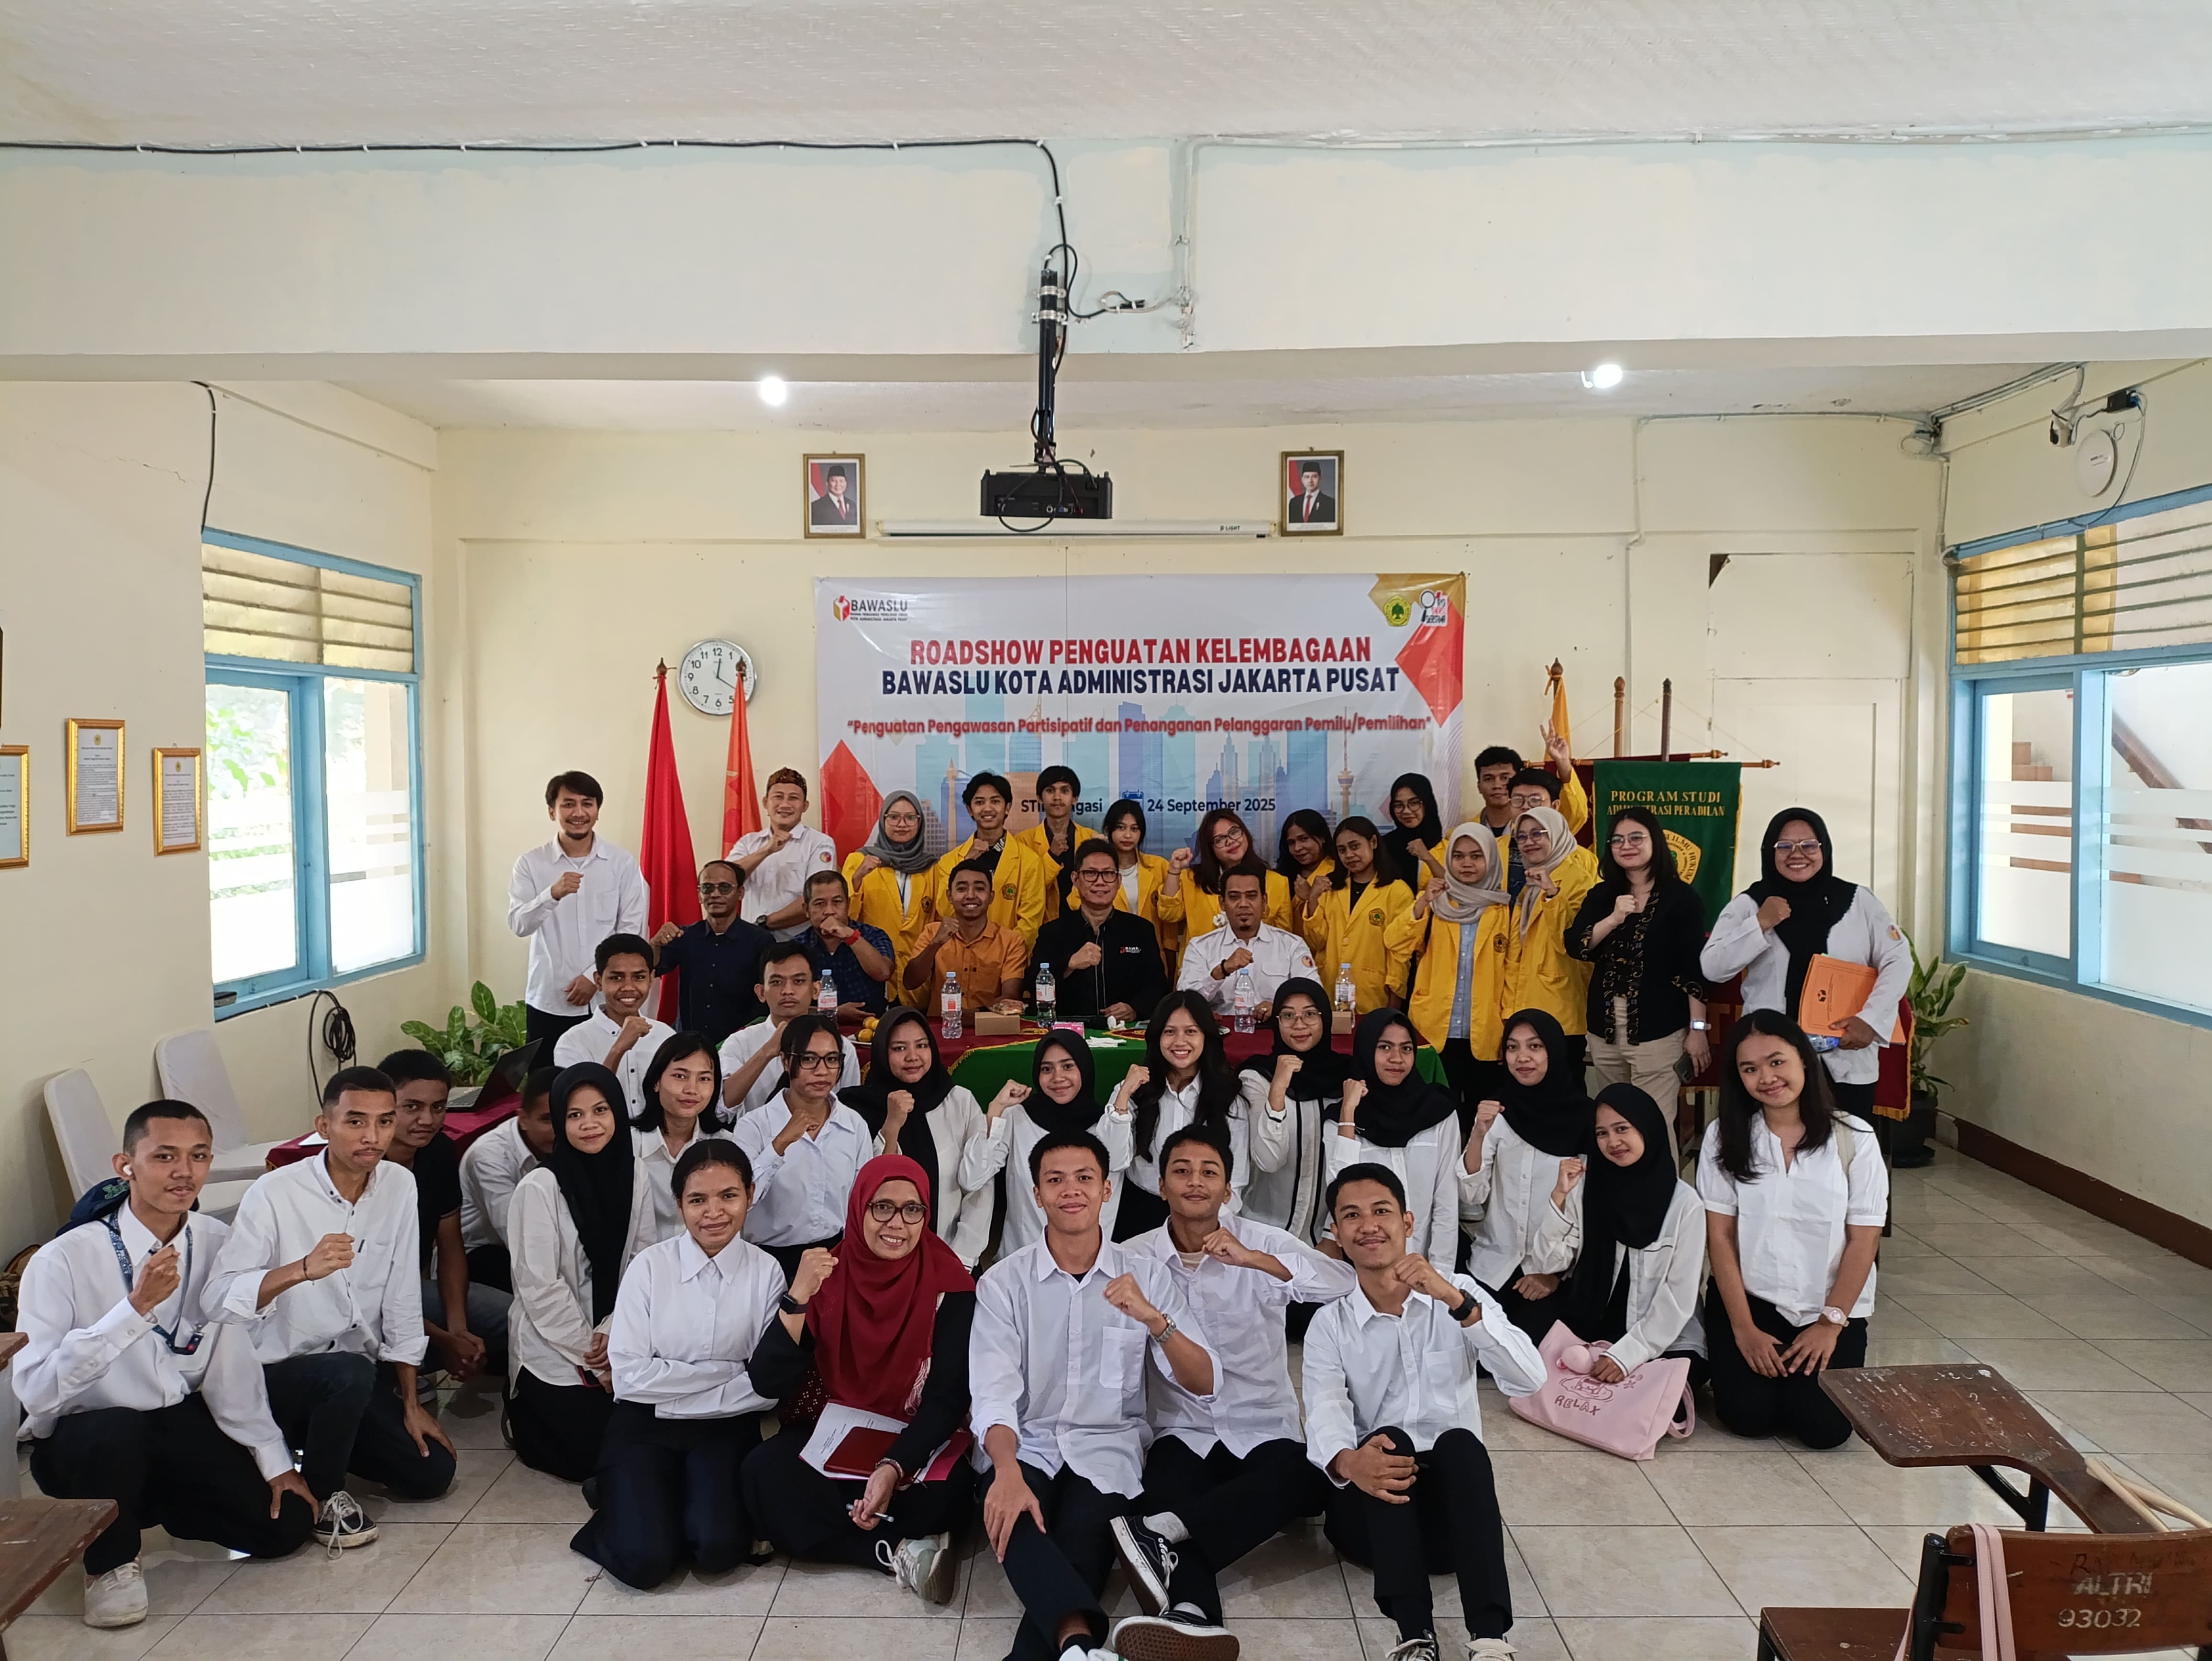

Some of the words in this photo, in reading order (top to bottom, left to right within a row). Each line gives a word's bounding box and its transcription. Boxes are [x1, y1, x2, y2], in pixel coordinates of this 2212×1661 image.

[851, 599, 907, 611] BAWASLU
[700, 651, 708, 659] 11
[712, 647, 722, 656] 12
[911, 640, 1043, 664] ROADSHOW
[1050, 639, 1190, 664] PENGUATAN
[1196, 637, 1371, 663] KELEMBAGAAN
[729, 652, 733, 660] 1
[691, 660, 701, 669] 10
[688, 673, 694, 681] 9
[882, 670, 990, 695] BAWASLU
[995, 670, 1052, 695] KOTA
[1057, 669, 1213, 694] ADMINISTRASI
[1218, 668, 1322, 693] JAKARTA
[1327, 667, 1400, 692] PUSAT
[693, 686, 699, 695] 8
[703, 695, 709, 703] 7
[716, 699, 722, 707] 6
[729, 696, 734, 704] 5
[928, 720, 1015, 737] Pengawasan
[1018, 718, 1093, 737] Partisipatif
[1095, 718, 1122, 732] dan
[1125, 718, 1211, 736] Penanganan
[1214, 717, 1302, 736] Pelanggaran
[1611, 791, 1678, 802] PROGRAM
[1682, 791, 1721, 803] STUDI
[1147, 799, 1164, 811] 24
[1167, 798, 1241, 815] September
[1244, 798, 1276, 811] 2025
[1674, 806, 1725, 816] PERADILAN
[1554, 1395, 1601, 1416] RELAX
[2057, 1609, 2142, 1628] 93032
